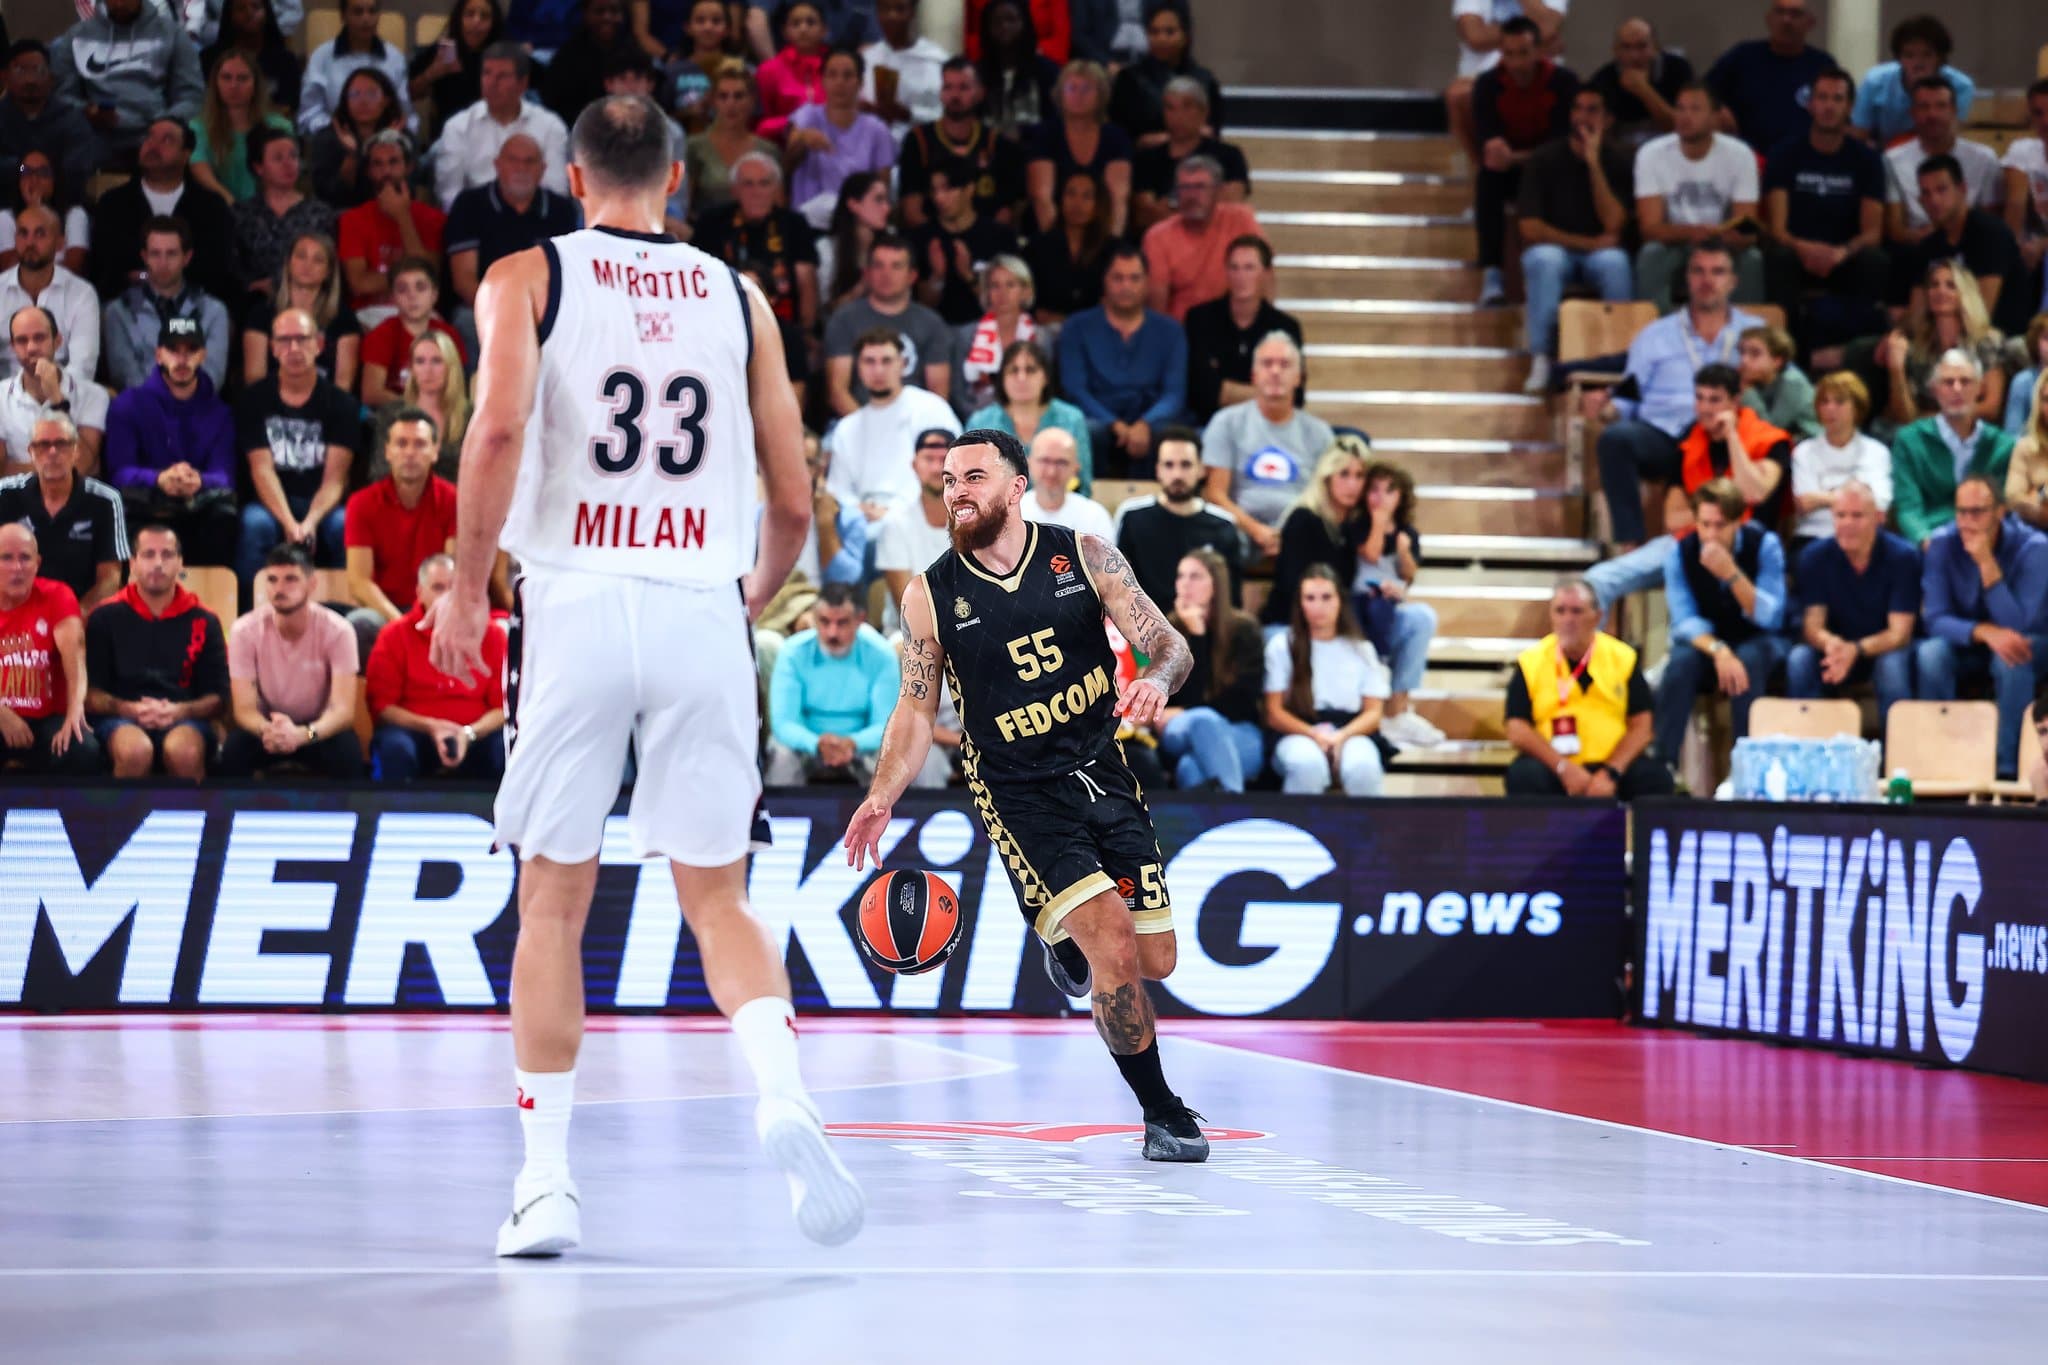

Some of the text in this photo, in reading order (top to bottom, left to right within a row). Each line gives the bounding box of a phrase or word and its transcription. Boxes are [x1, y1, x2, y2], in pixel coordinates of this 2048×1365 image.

[592, 257, 708, 300] MIROTIĆ
[590, 366, 712, 480] 33
[573, 501, 706, 549] MILAN
[1006, 627, 1064, 682] 55
[994, 664, 1109, 743] FEDCOM
